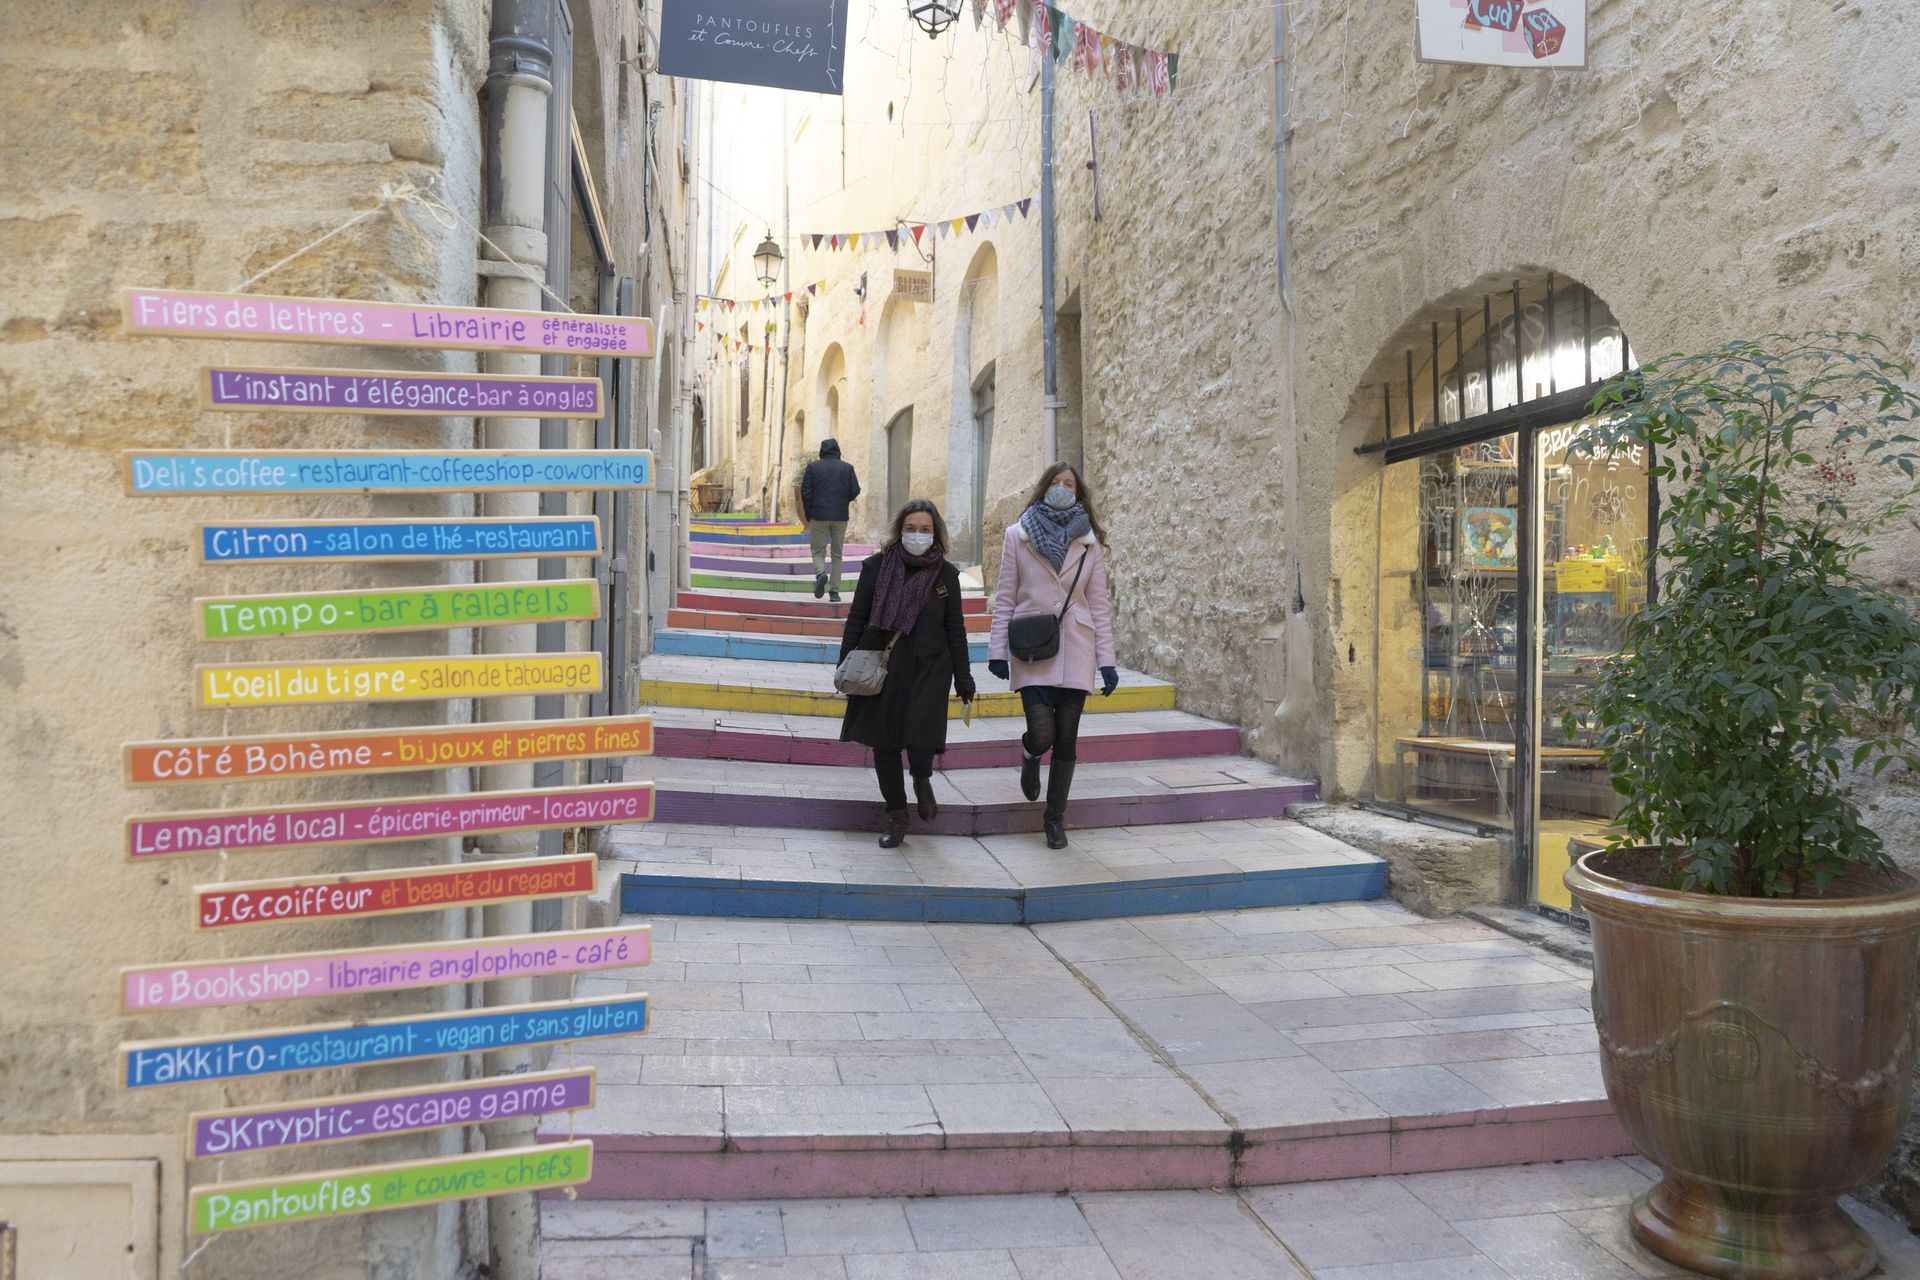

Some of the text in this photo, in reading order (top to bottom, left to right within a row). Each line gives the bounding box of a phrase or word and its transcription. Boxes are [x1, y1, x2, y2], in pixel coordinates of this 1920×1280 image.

[688, 30, 707, 41] et
[696, 14, 812, 38] PANTOUFLES
[140, 296, 217, 326] Fiers
[224, 301, 257, 328] de
[269, 303, 365, 334] lettres
[412, 312, 526, 341] Librairie
[542, 318, 626, 336] Généraliste
[544, 332, 627, 350] et engagée
[219, 373, 336, 403] L'instant
[533, 384, 594, 410] ongles
[135, 459, 206, 488] Deli's
[213, 528, 307, 556] Citron
[402, 526, 428, 549] de
[420, 594, 438, 619] à
[451, 588, 568, 618] falafels
[209, 669, 280, 698] L'oeil
[288, 669, 318, 696] du
[504, 663, 591, 687] tatouage
[153, 745, 233, 778] Côté
[246, 744, 372, 772] Bohème
[400, 738, 484, 762] bijoux
[492, 733, 511, 757] et
[518, 730, 586, 756] pierres
[594, 727, 640, 750] fines
[286, 813, 344, 841] local
[381, 878, 400, 905] et
[406, 874, 473, 904] beauté
[478, 872, 503, 896] du
[508, 865, 576, 894] regard
[138, 976, 164, 1008] le
[429, 948, 556, 978] anglophone
[576, 936, 628, 964] café
[436, 1024, 494, 1050] vegan
[501, 1016, 520, 1042] et
[527, 1016, 568, 1040] sans
[574, 1006, 638, 1036] gluten
[479, 1083, 566, 1118] game
[208, 1180, 371, 1230] Pantoufles
[384, 1180, 406, 1200] et
